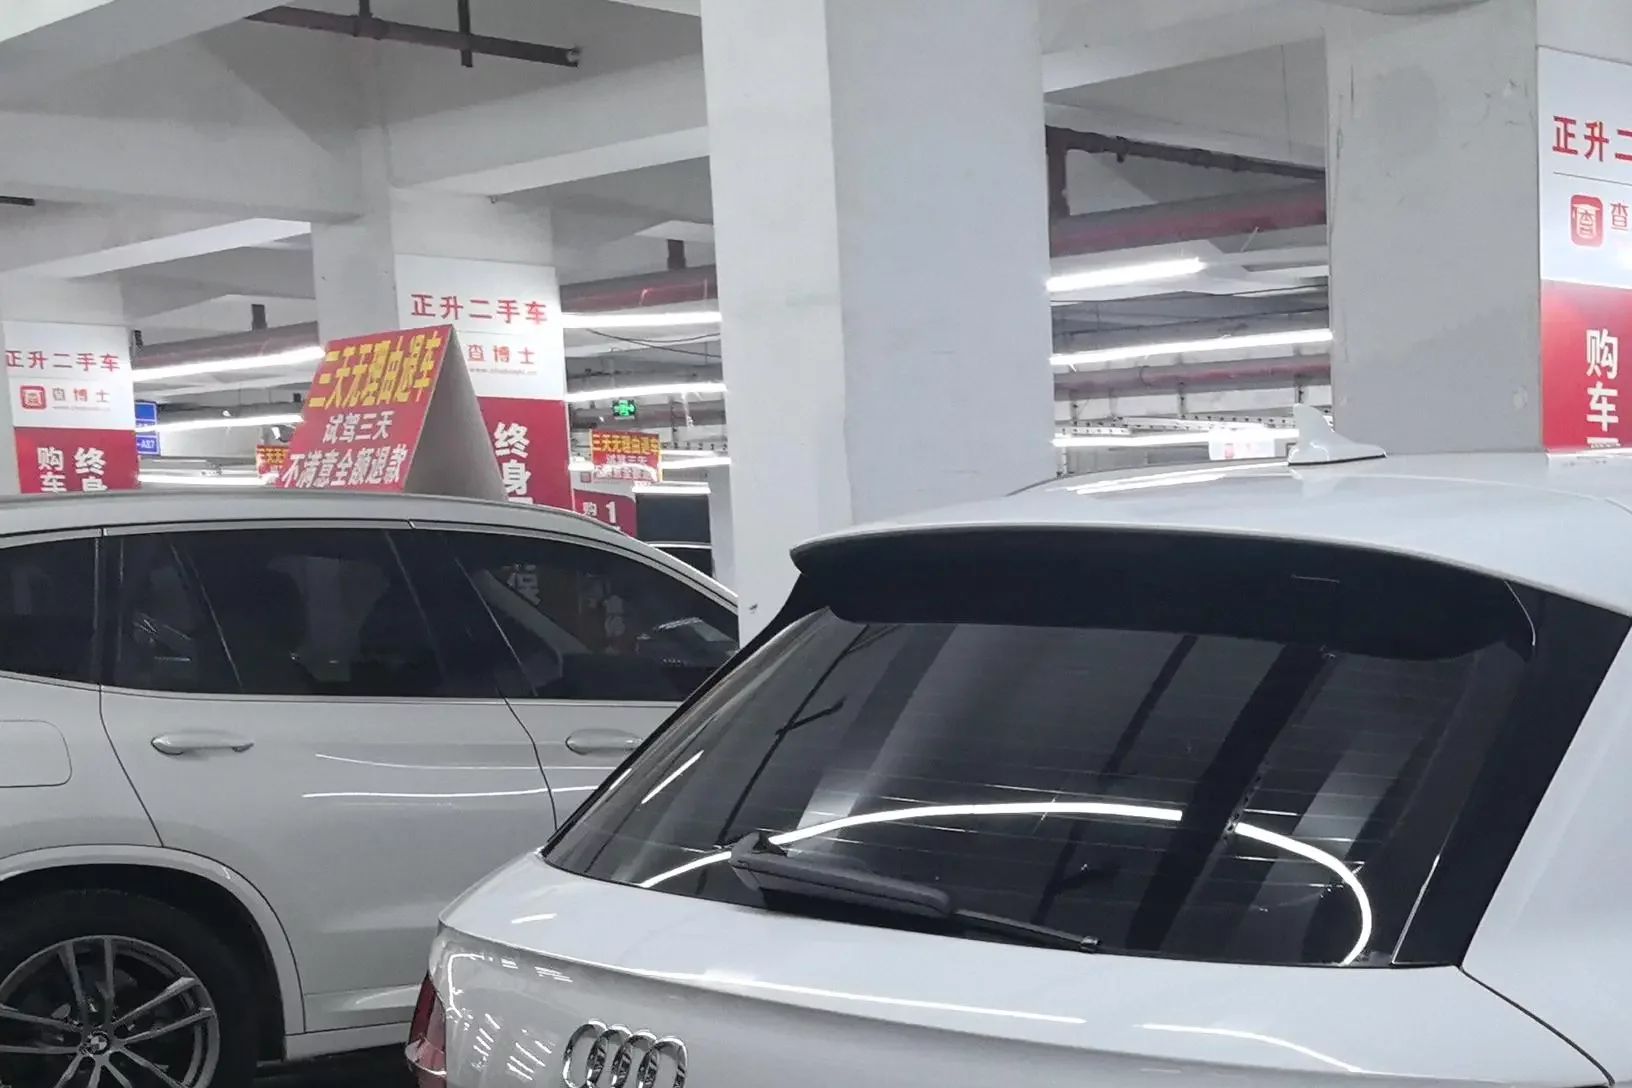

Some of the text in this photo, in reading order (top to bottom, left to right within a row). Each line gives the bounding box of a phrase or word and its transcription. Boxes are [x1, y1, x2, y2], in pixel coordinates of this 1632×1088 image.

[411, 293, 547, 323] 正升二手车
[5, 350, 120, 372] 正升二手车
[309, 331, 443, 409] 三天无理由退车
[1586, 328, 1620, 448] 购车
[323, 411, 394, 444] 试驾三天
[494, 422, 533, 504] 终身
